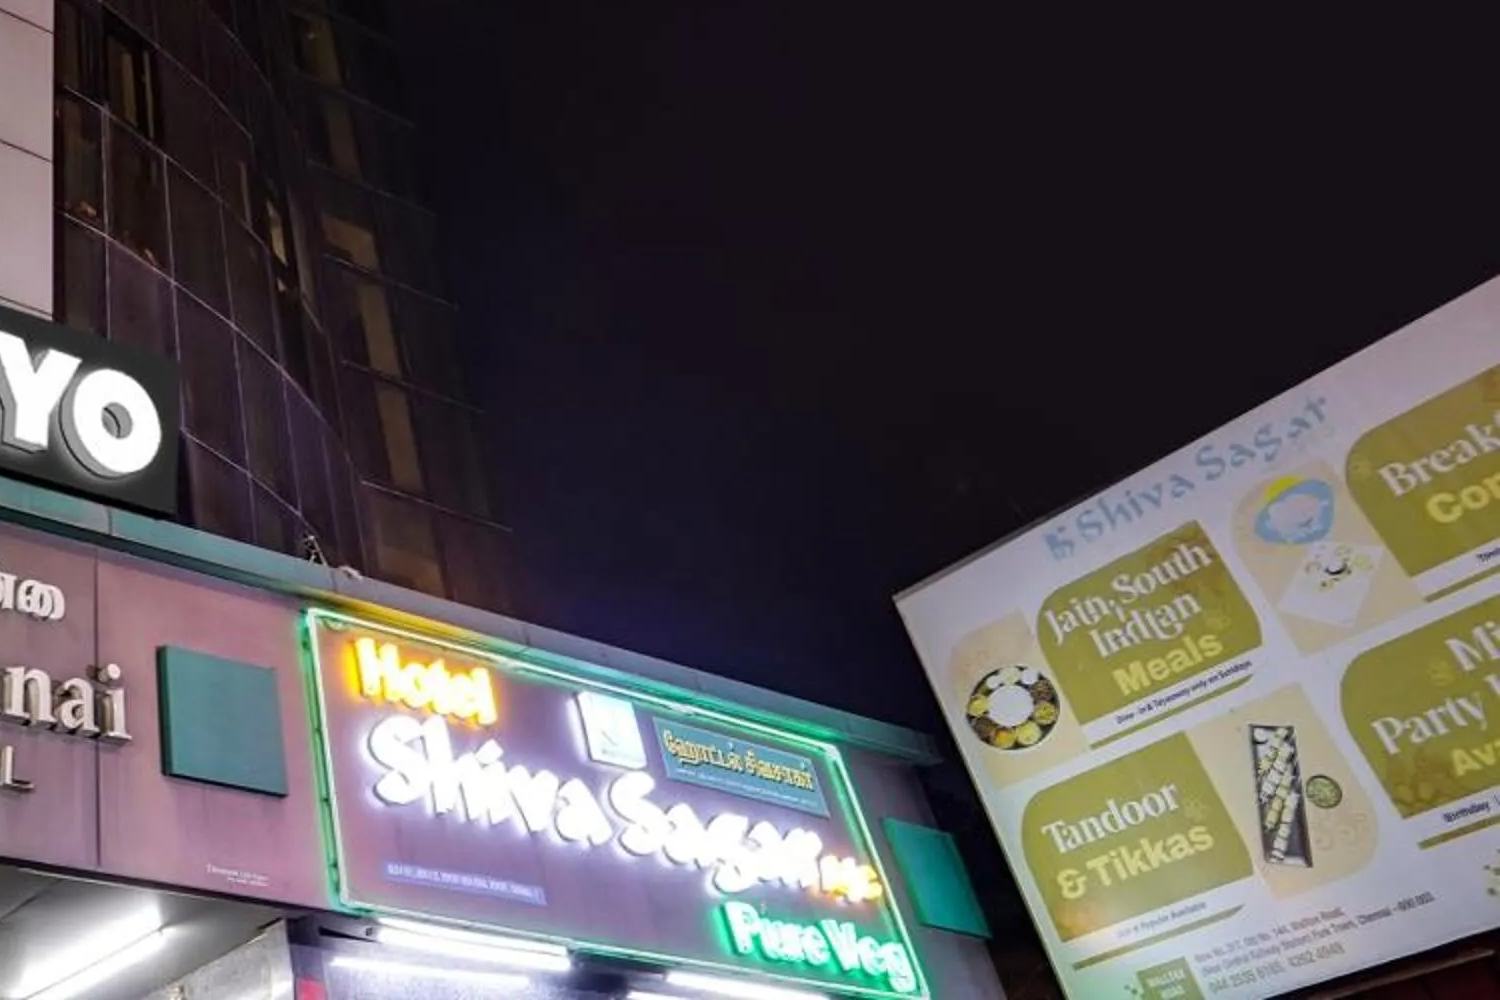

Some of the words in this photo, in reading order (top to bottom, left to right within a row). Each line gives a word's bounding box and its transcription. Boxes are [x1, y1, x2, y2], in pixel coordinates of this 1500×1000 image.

[1075, 474, 1195, 541] Shiva
[1196, 396, 1327, 481] Sagar
[1378, 410, 1500, 496] Break
[1111, 544, 1214, 604] South
[1089, 592, 1202, 658] Indian
[352, 636, 498, 726] Hotel
[1112, 633, 1224, 696] Meals
[1370, 691, 1488, 756] Party
[1452, 740, 1500, 776] Av
[366, 714, 613, 847] Shiva
[608, 771, 824, 894] Sagar
[1041, 784, 1179, 854] Tandoor
[1056, 868, 1088, 900] &
[1085, 825, 1215, 887] Tikkas
[719, 900, 832, 966] Pure
[818, 918, 917, 993] Veg
